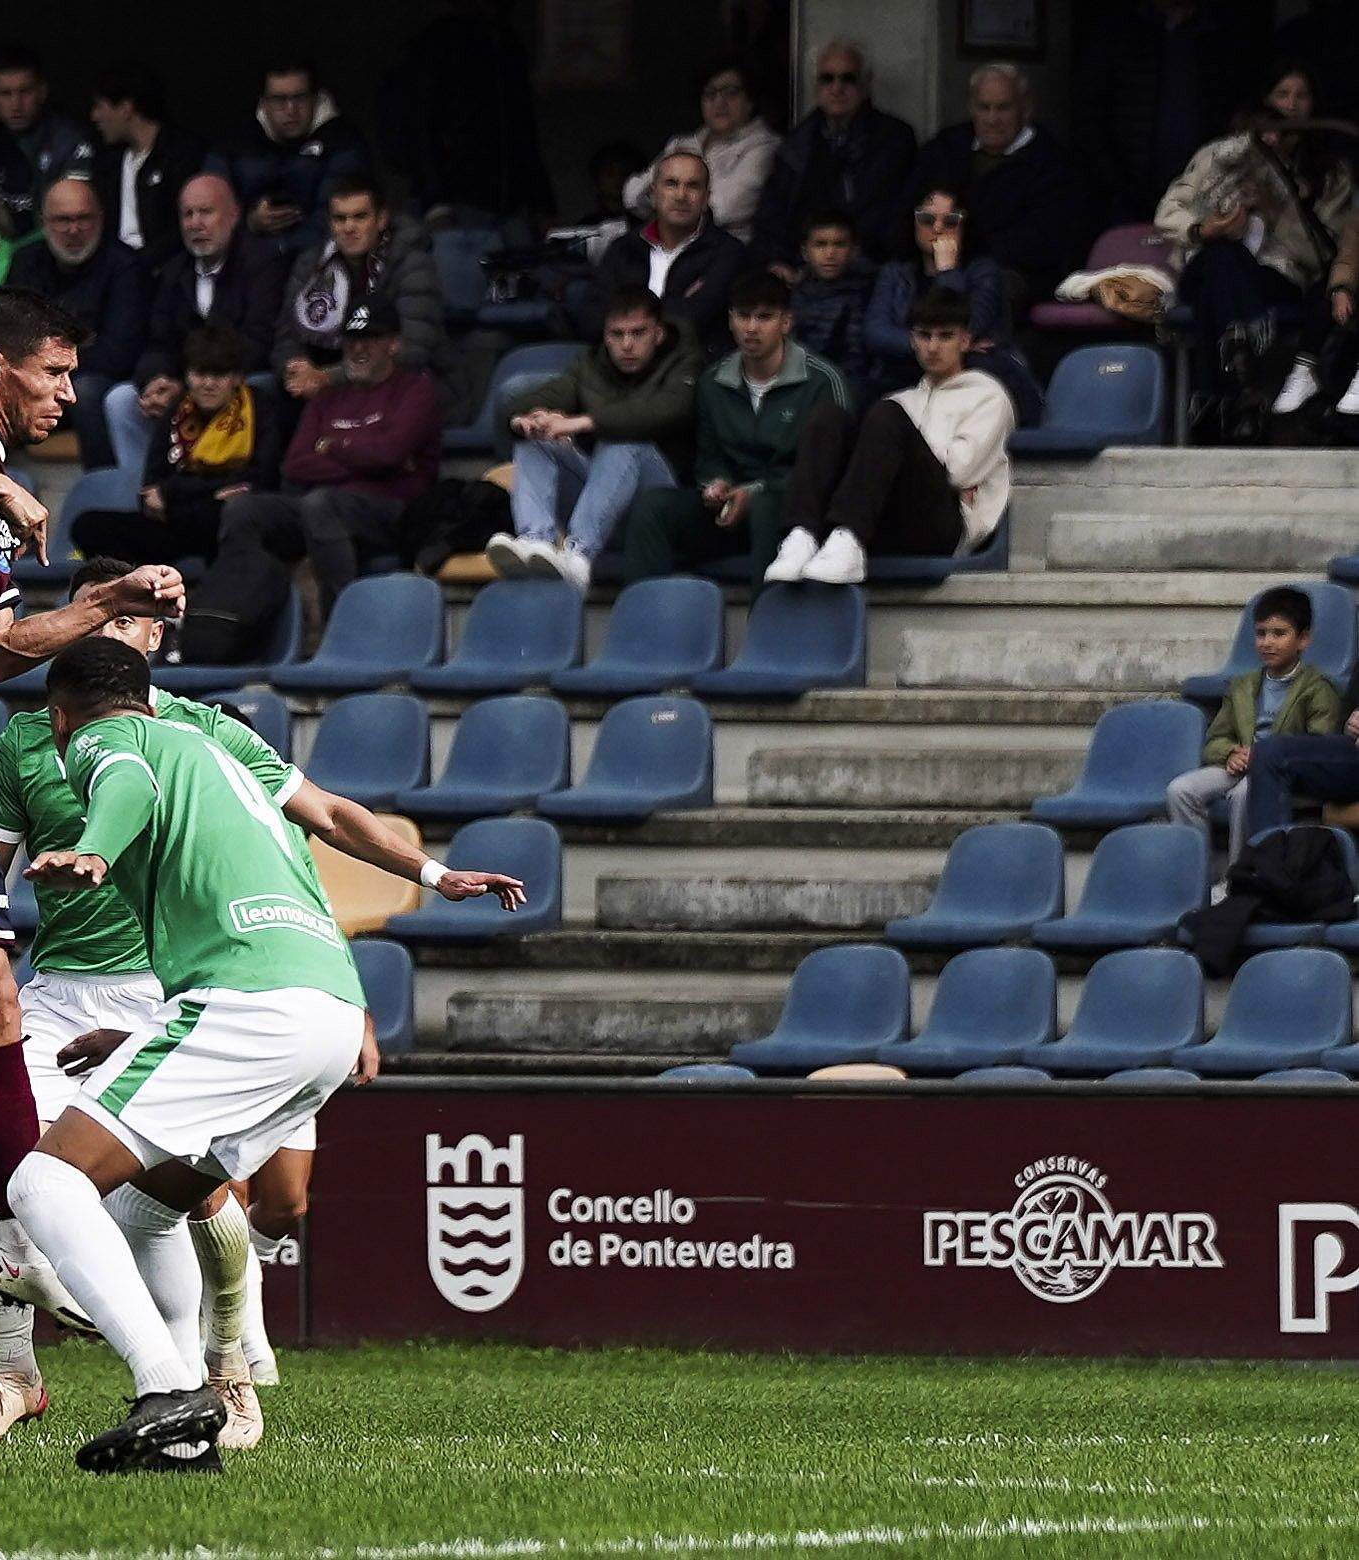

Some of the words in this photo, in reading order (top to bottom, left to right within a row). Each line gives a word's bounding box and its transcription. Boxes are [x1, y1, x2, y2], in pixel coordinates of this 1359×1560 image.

[1013, 1155, 1109, 1190] CONSERVAS
[547, 1187, 696, 1224] Concello
[547, 1231, 593, 1267] de
[598, 1232, 796, 1270] Pontevedra
[923, 1210, 1225, 1269] PESCAMAR
